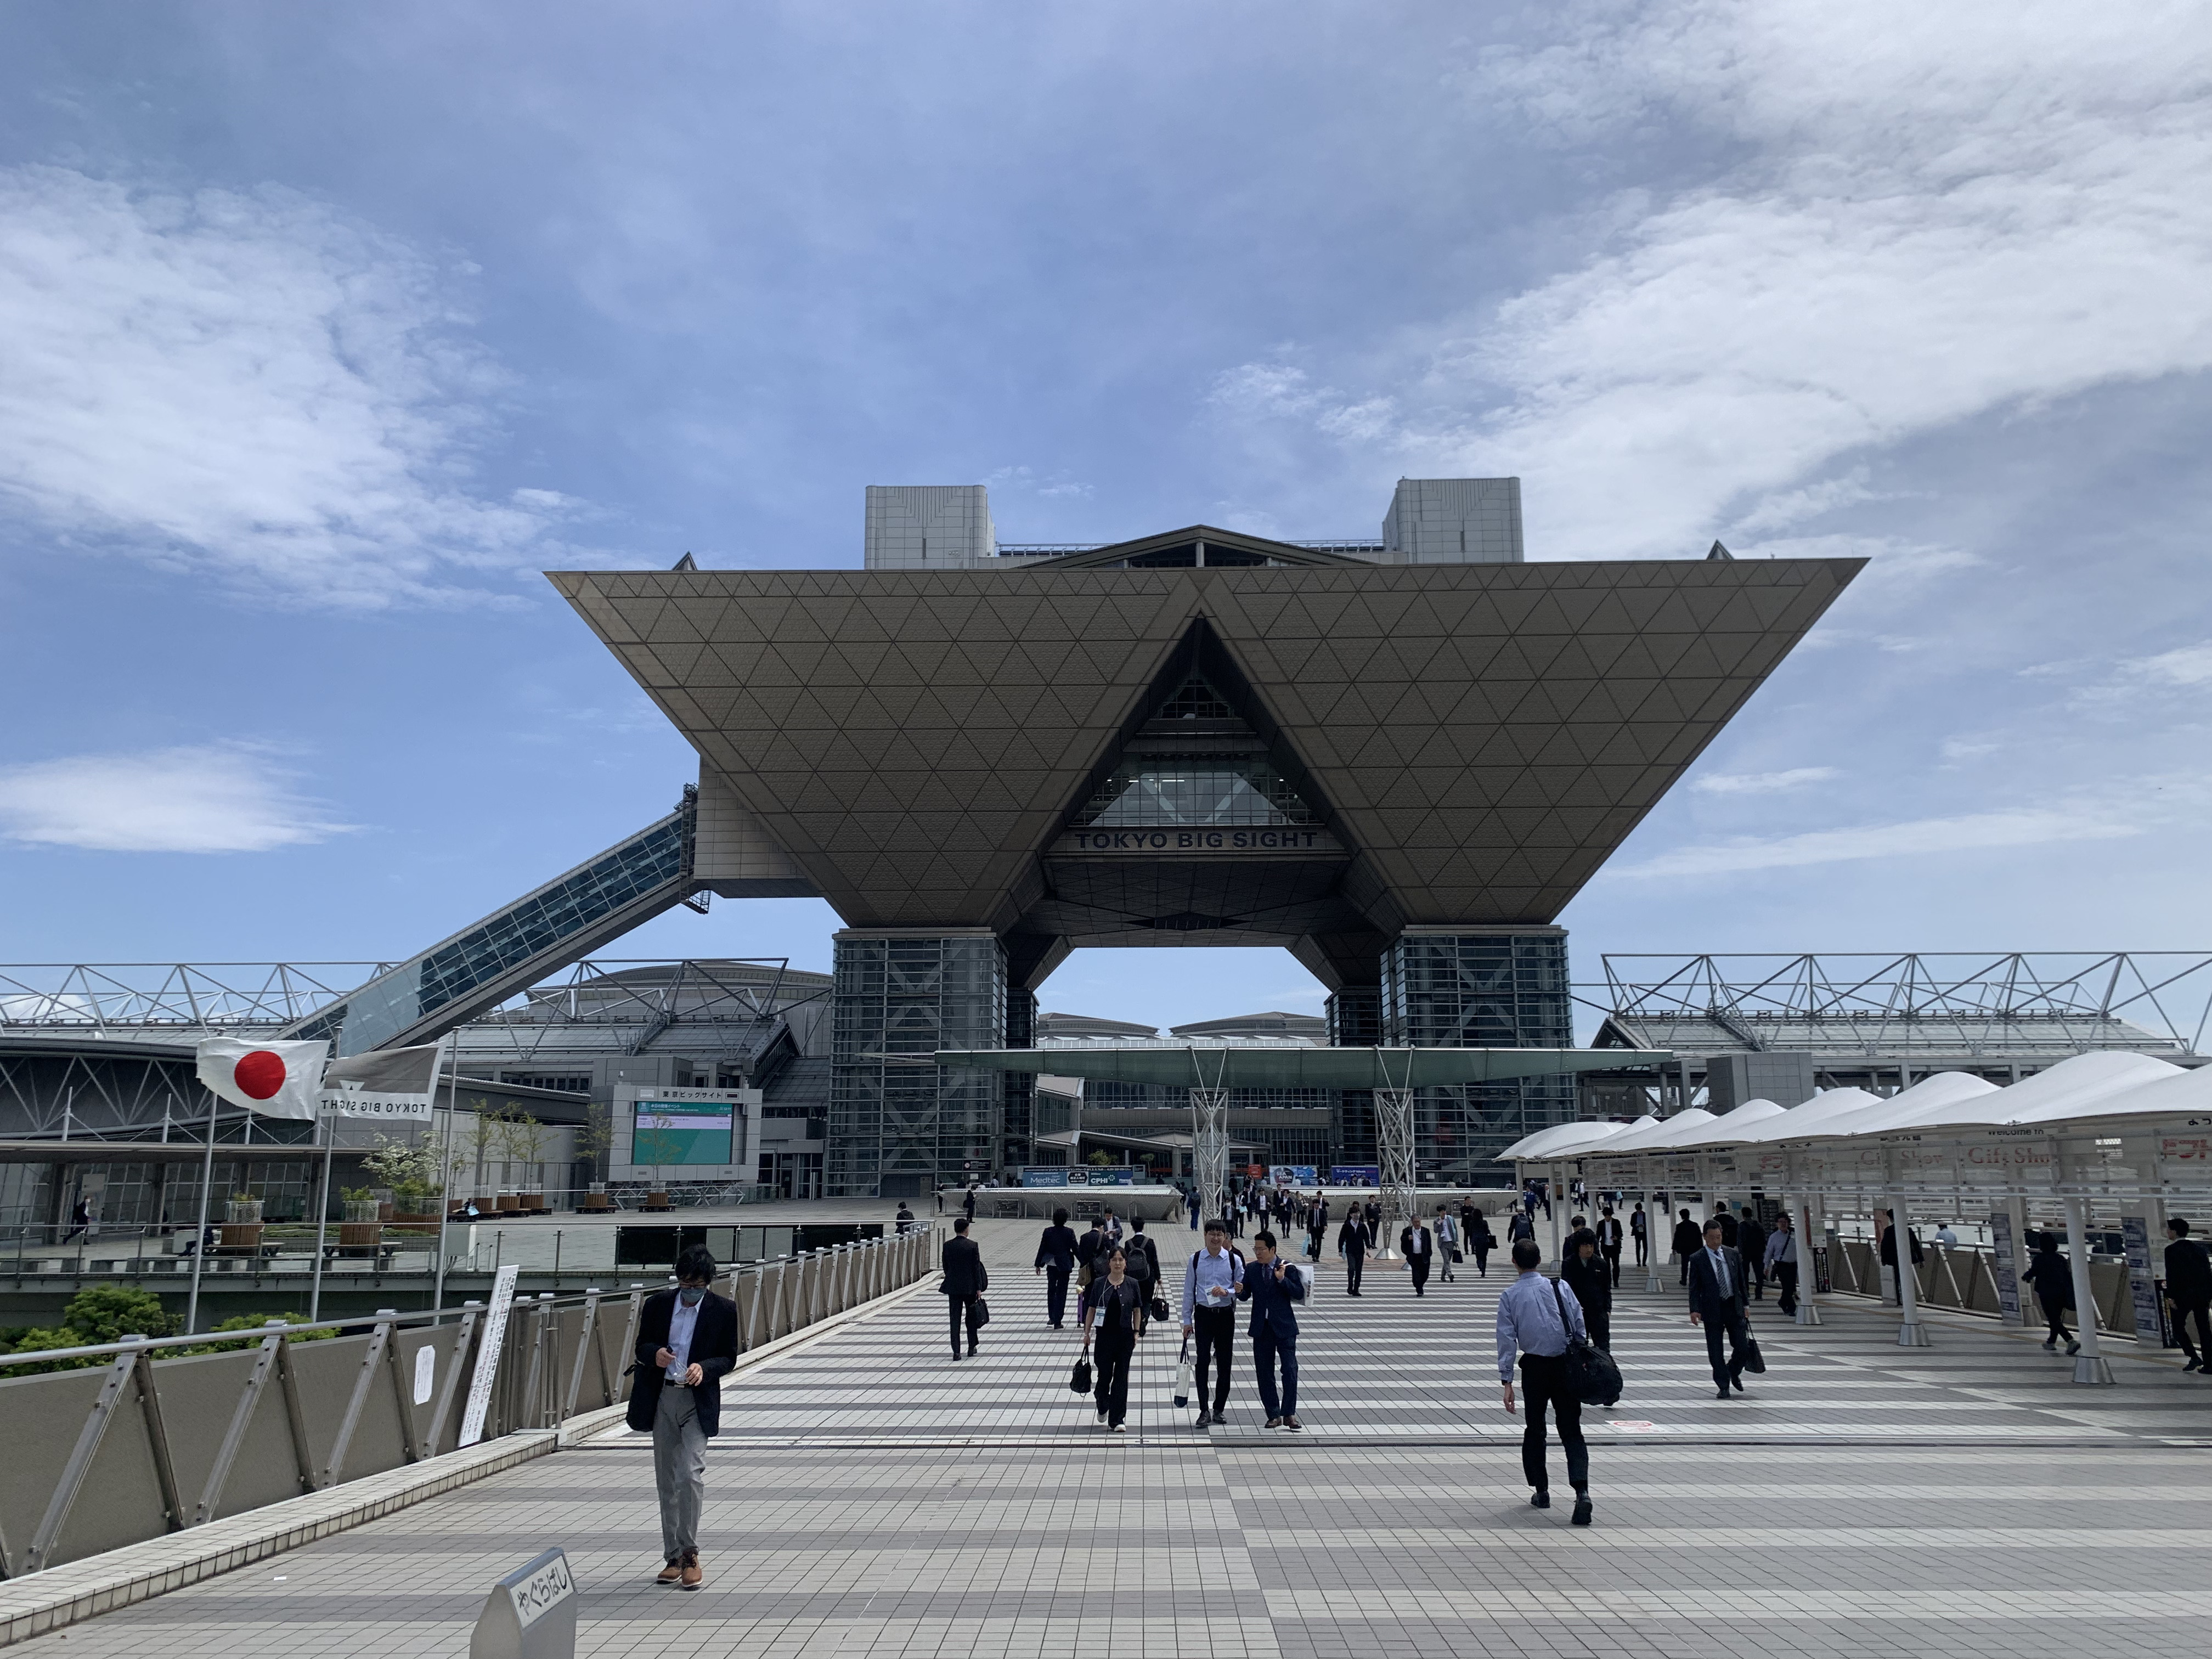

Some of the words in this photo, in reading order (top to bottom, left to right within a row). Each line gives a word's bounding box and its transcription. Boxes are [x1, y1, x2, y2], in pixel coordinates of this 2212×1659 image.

[1075, 832, 1167, 849] TOKYO
[1178, 832, 1223, 848] BIG
[1233, 831, 1317, 848] SIGHT
[663, 1091, 721, 1099] 東京ビッグサイト
[517, 1566, 567, 1617] やぐらばし
